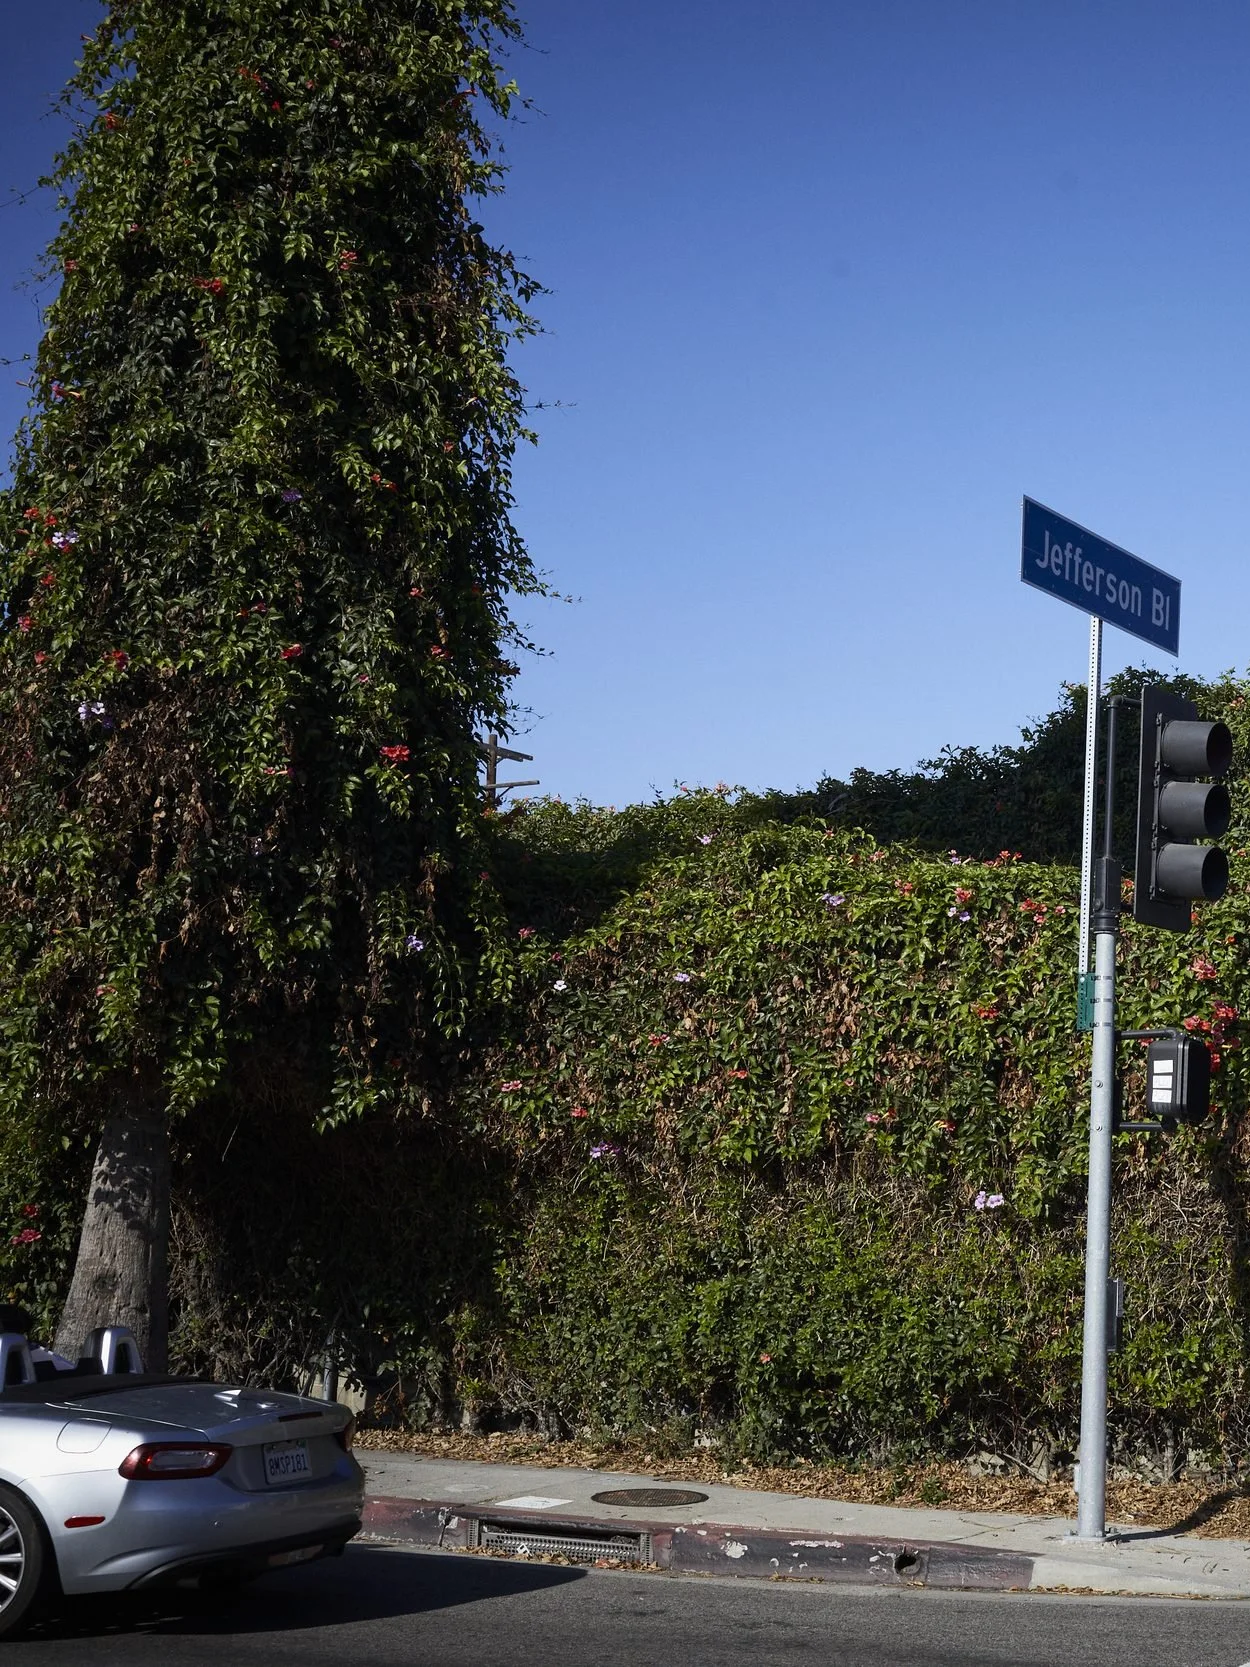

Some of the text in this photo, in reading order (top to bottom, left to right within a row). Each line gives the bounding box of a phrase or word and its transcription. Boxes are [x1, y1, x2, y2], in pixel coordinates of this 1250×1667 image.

[1035, 530, 1170, 631] Jefferson Bl
[268, 1453, 309, 1476] 8MSP181
